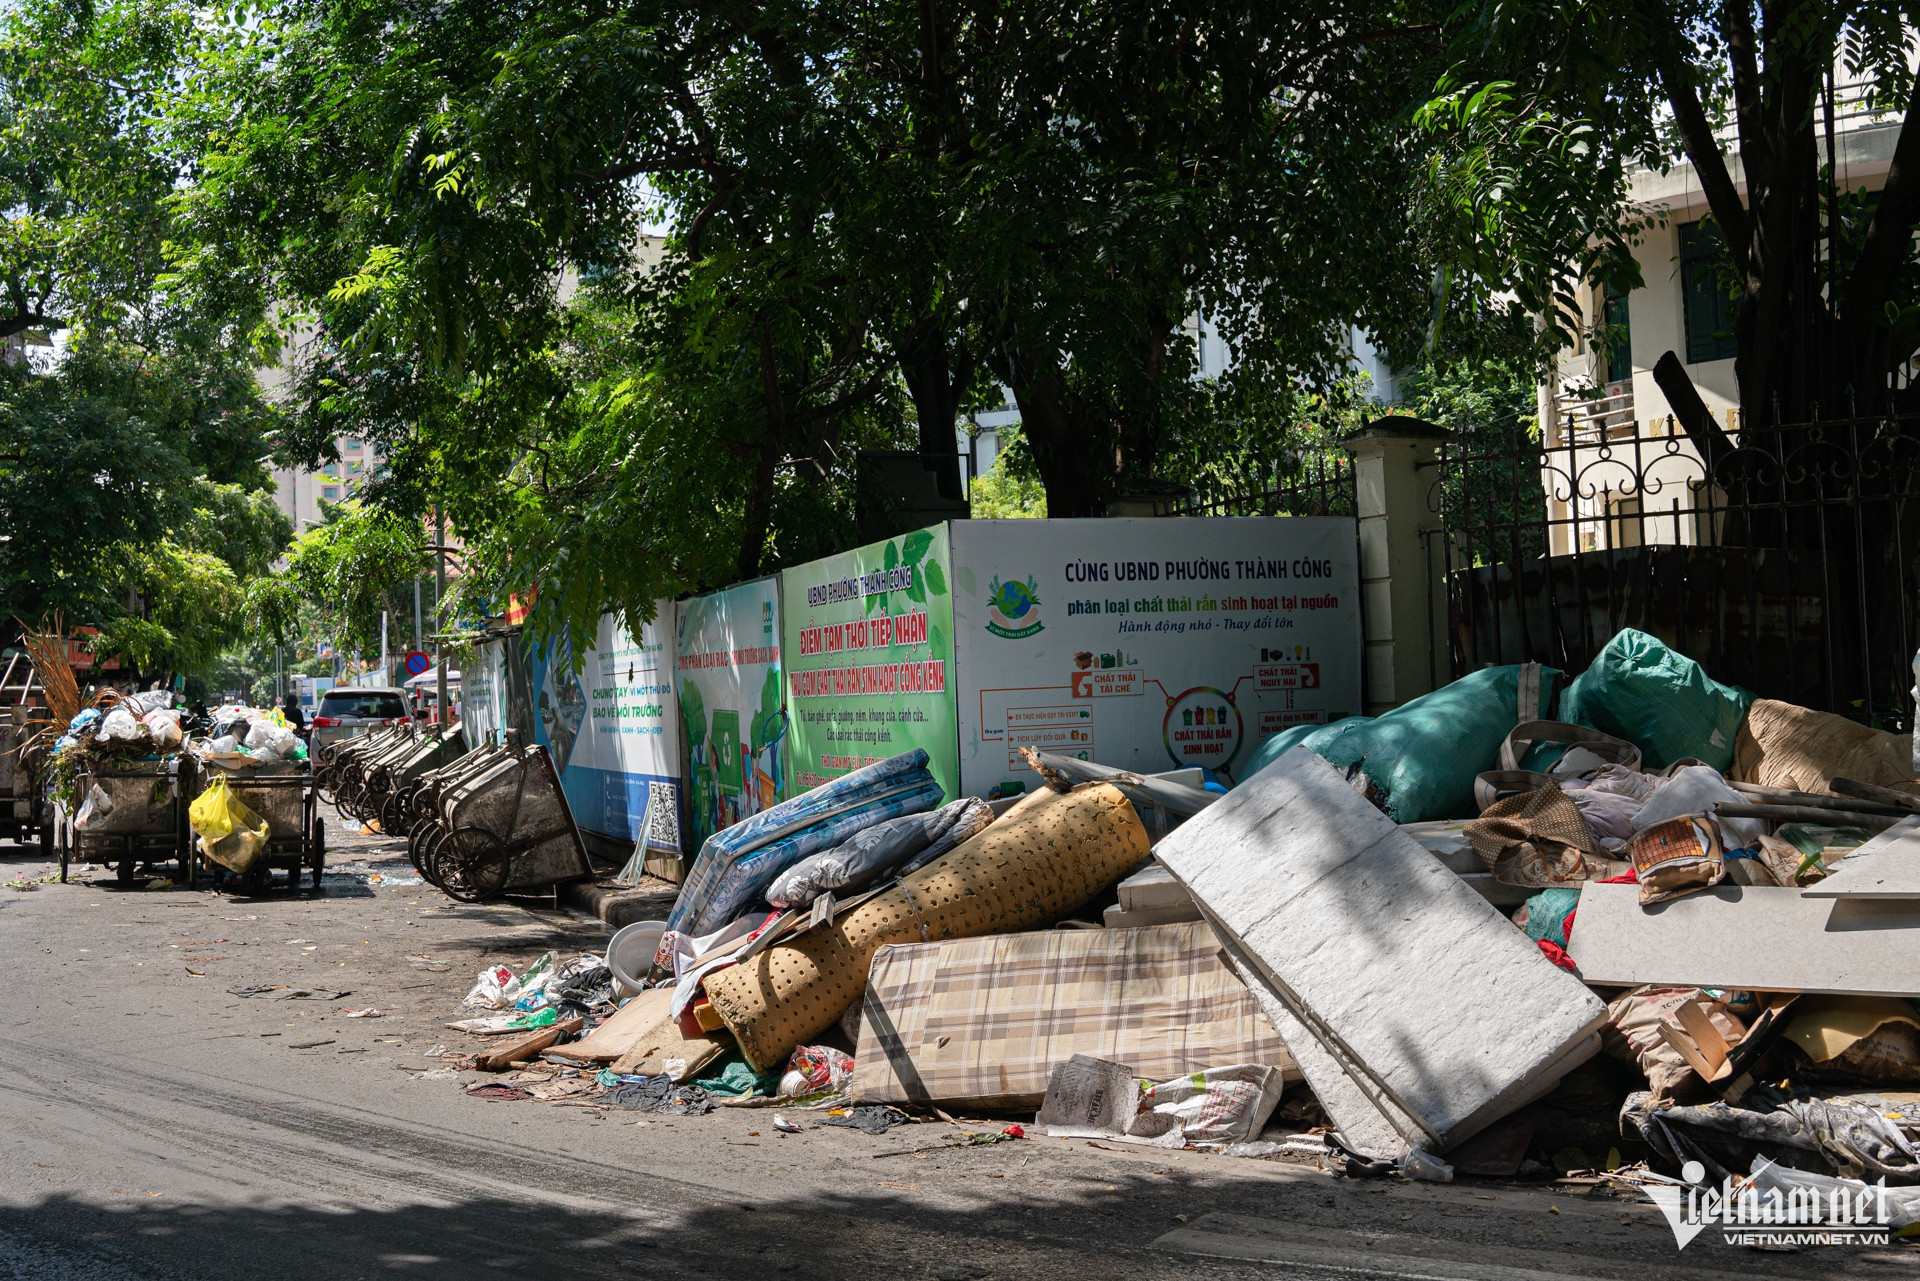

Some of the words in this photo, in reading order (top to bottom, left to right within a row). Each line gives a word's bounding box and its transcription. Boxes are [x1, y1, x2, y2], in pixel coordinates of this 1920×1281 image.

[1065, 558, 1109, 582] CÙNG
[1114, 561, 1160, 581] UBND
[1165, 557, 1230, 580] PHƯỜNG
[1235, 556, 1288, 579] THÀNH
[1292, 556, 1332, 579] CÔNG
[807, 584, 827, 607] UBND
[828, 575, 858, 603] PHƯỜNG
[859, 569, 887, 597] THÀNH
[888, 563, 912, 591] CÔNG
[1067, 599, 1101, 616] phân
[1104, 599, 1130, 616] loại
[1133, 595, 1163, 613] chất
[1166, 595, 1192, 612] thải
[1196, 593, 1217, 611] rắn
[1221, 596, 1247, 611] sinh
[1250, 596, 1279, 613] hoạt
[1281, 595, 1298, 612] tại
[1301, 592, 1339, 610] nguồn
[800, 617, 822, 656] ĐIỂM
[823, 624, 843, 659] TẠM
[845, 614, 869, 651] THỜI
[870, 606, 893, 648] TIẾP
[894, 606, 928, 652] NHẬN
[1118, 620, 1151, 634] Hành
[1154, 620, 1186, 634] động
[1189, 619, 1212, 631] nhỏ
[1223, 619, 1251, 632] Thay
[1253, 615, 1272, 629] đổi
[1275, 617, 1294, 629] lớn
[703, 651, 716, 671] LOẠI
[716, 648, 728, 667] RÁC
[802, 670, 816, 697] GOM
[817, 659, 831, 697] CHẤT
[847, 656, 861, 696] RẮN
[861, 665, 877, 695] SINH
[877, 663, 898, 701] HOẠT
[1094, 672, 1115, 683] CHẤT
[1117, 672, 1136, 682] THẢI
[1258, 666, 1279, 677] CHẤT
[1280, 666, 1297, 676] THẢI
[593, 687, 614, 700] CHUNG
[614, 686, 628, 698] TAY
[636, 684, 648, 696] MỘT
[649, 682, 660, 694] THỦ
[661, 682, 671, 694] ĐÔ
[1099, 684, 1113, 693] TÁI
[1115, 683, 1131, 693] CHẾ
[1260, 678, 1282, 687] NGUY
[1283, 678, 1296, 688] HẠI
[593, 704, 606, 718] BẢO
[607, 704, 616, 721] VỆ
[617, 704, 630, 718] MÔI
[631, 702, 663, 718] TRƯỜNG
[869, 707, 884, 725] khung
[621, 726, 633, 734] XANH
[1174, 728, 1195, 741] CHẤT
[1196, 727, 1214, 739] THẢI
[1215, 726, 1232, 738] RẮN
[1183, 744, 1203, 755] SINH
[1204, 743, 1224, 756] HOẠT
